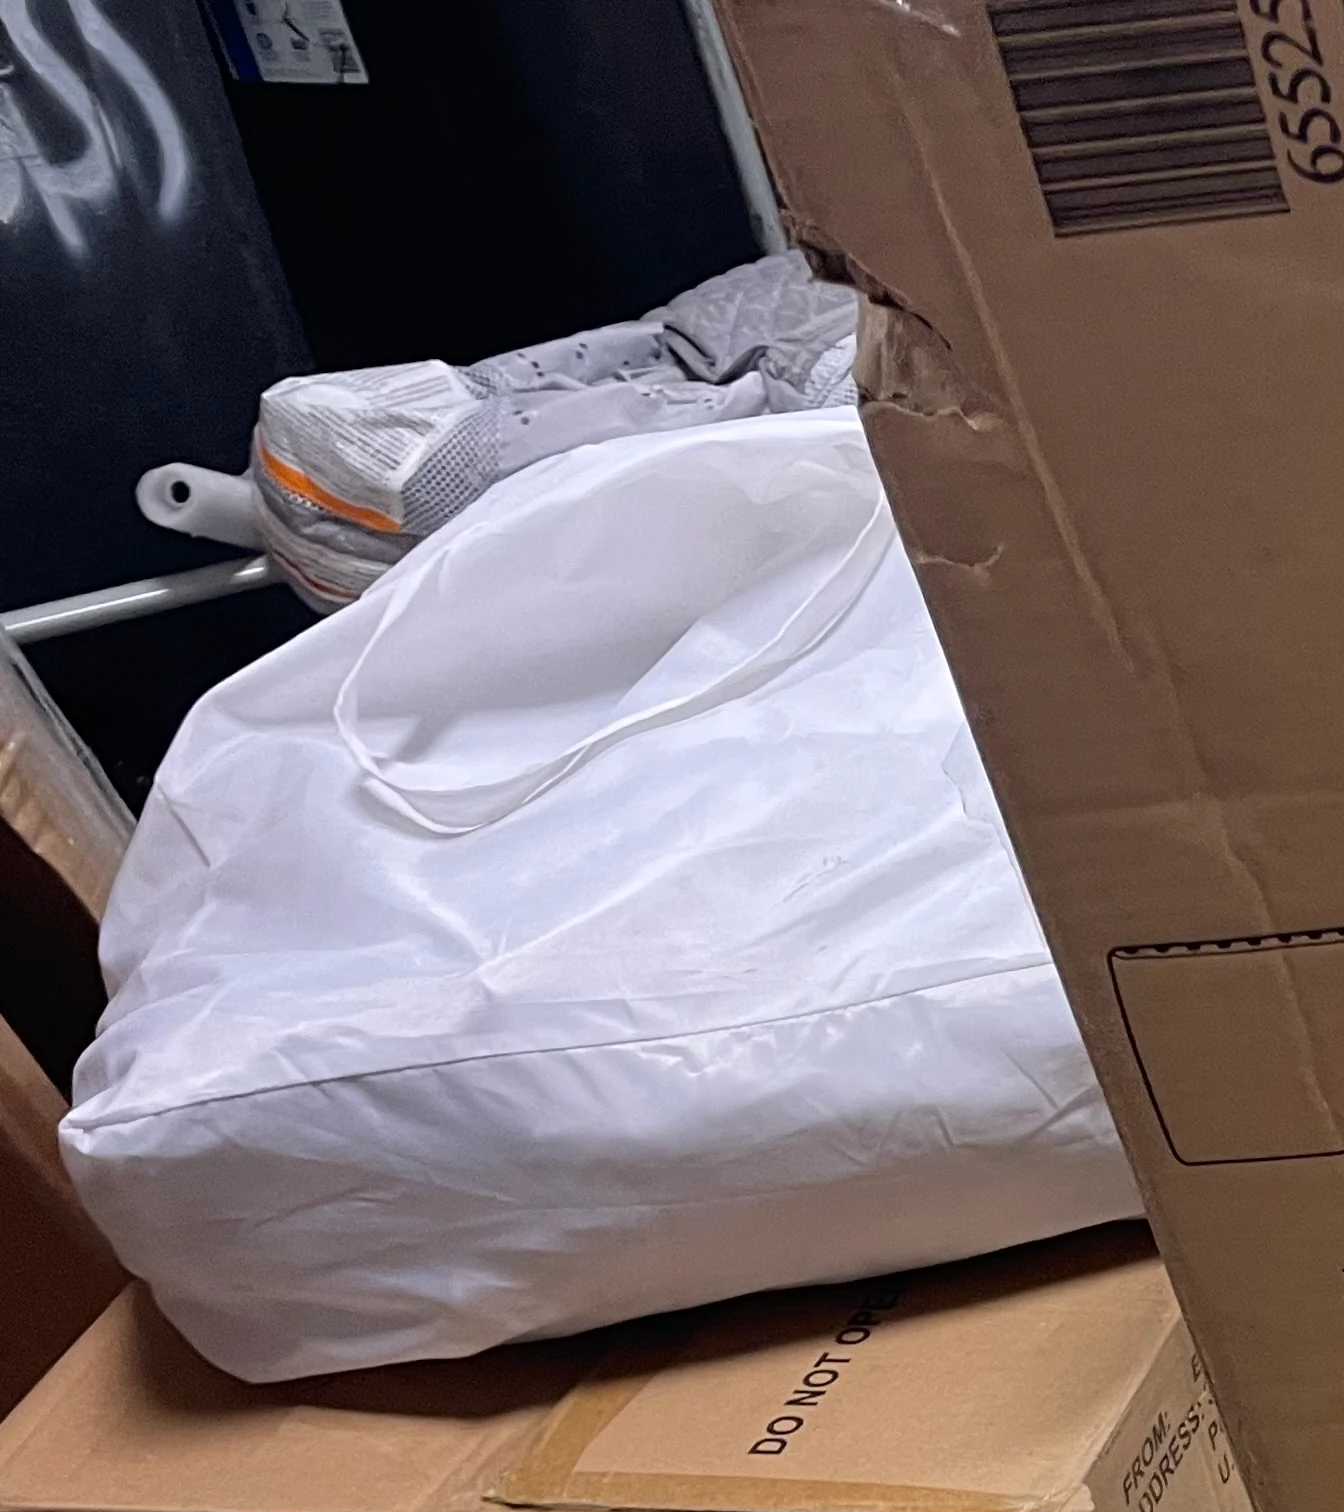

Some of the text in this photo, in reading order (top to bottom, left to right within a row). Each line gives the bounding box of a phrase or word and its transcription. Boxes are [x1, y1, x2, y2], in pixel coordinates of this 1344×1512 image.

[747, 1294, 900, 1454] DO NOT OPE
[1122, 1411, 1171, 1506] FROM:
